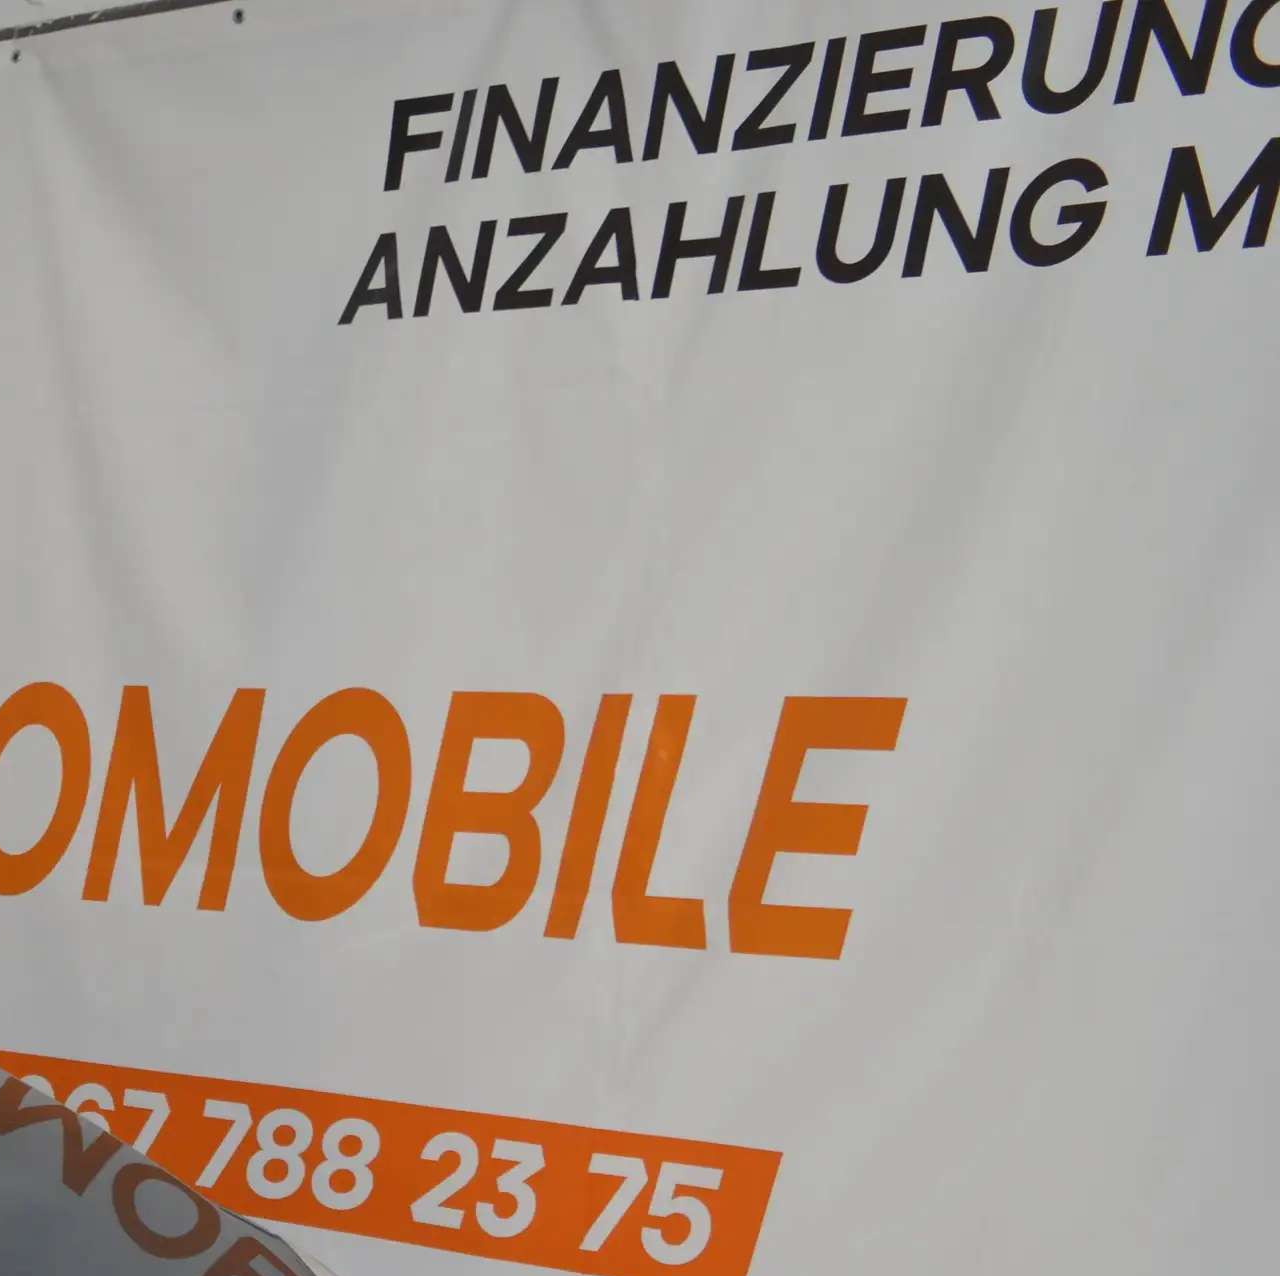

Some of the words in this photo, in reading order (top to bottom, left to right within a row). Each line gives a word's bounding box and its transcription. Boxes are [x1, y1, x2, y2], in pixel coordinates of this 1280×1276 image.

[337, 158, 1109, 325] ANZAHLUNG
[195, 1098, 381, 1210] 788
[410, 1132, 547, 1238] 23
[579, 1153, 725, 1267] 75
